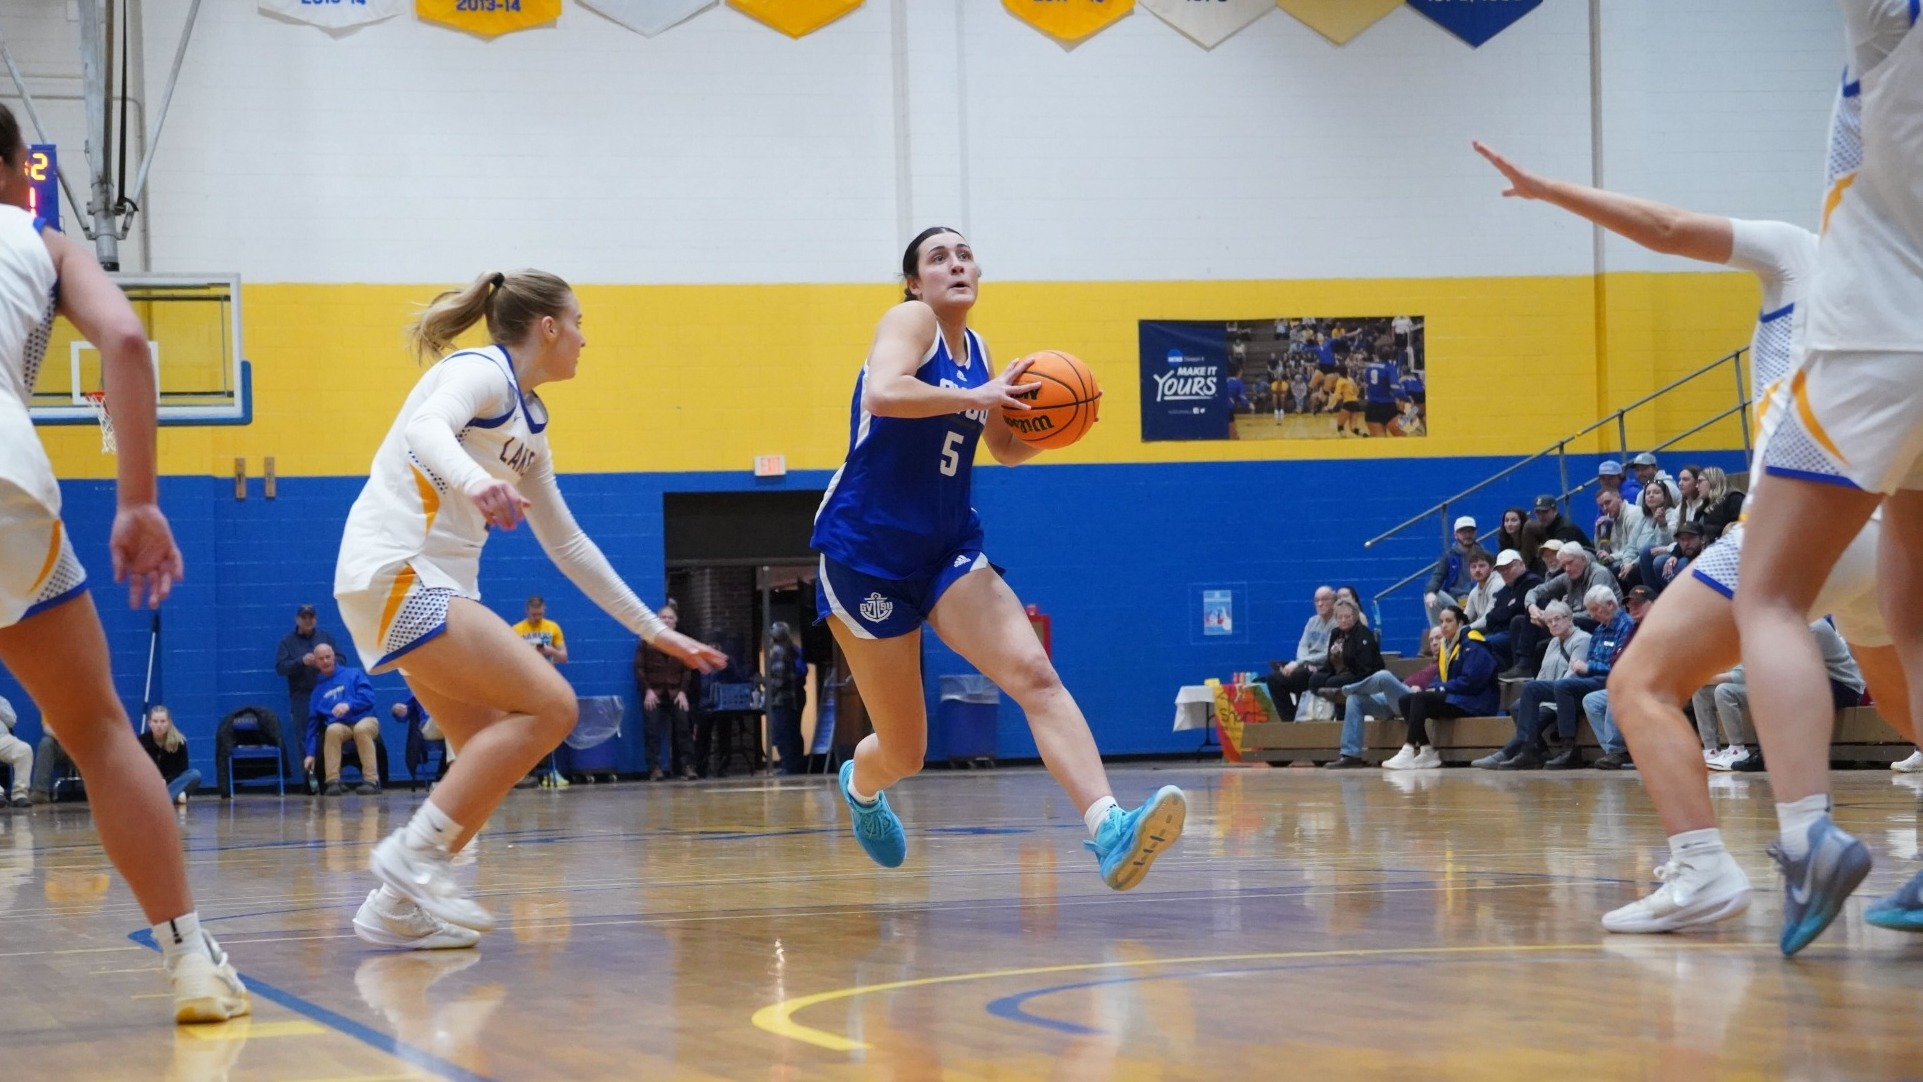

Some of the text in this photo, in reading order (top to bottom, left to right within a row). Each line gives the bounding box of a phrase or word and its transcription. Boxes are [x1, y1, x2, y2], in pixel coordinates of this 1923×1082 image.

[1153, 370, 1217, 402] YOURS
[1177, 366, 1218, 376] MAKE IT
[940, 430, 964, 477] 5
